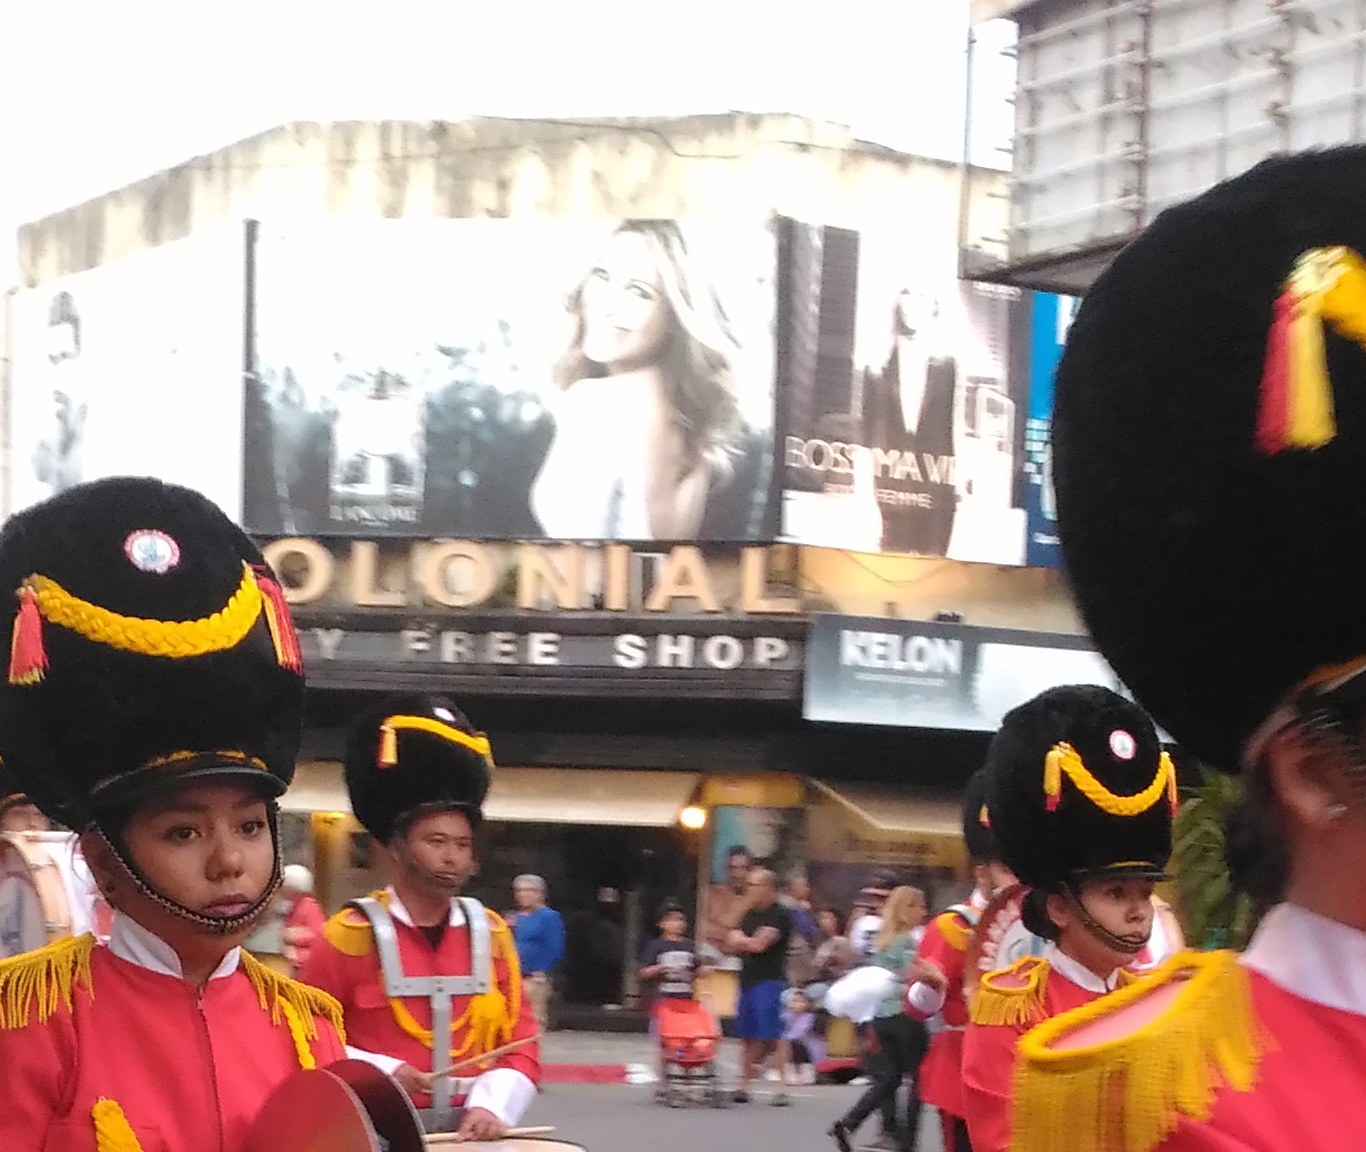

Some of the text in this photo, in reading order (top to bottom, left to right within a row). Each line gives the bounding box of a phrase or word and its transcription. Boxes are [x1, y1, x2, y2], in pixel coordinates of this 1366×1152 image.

[258, 538, 802, 613] OLONIAL
[401, 629, 790, 669] FREE SHOP
[840, 630, 963, 674] KELON
